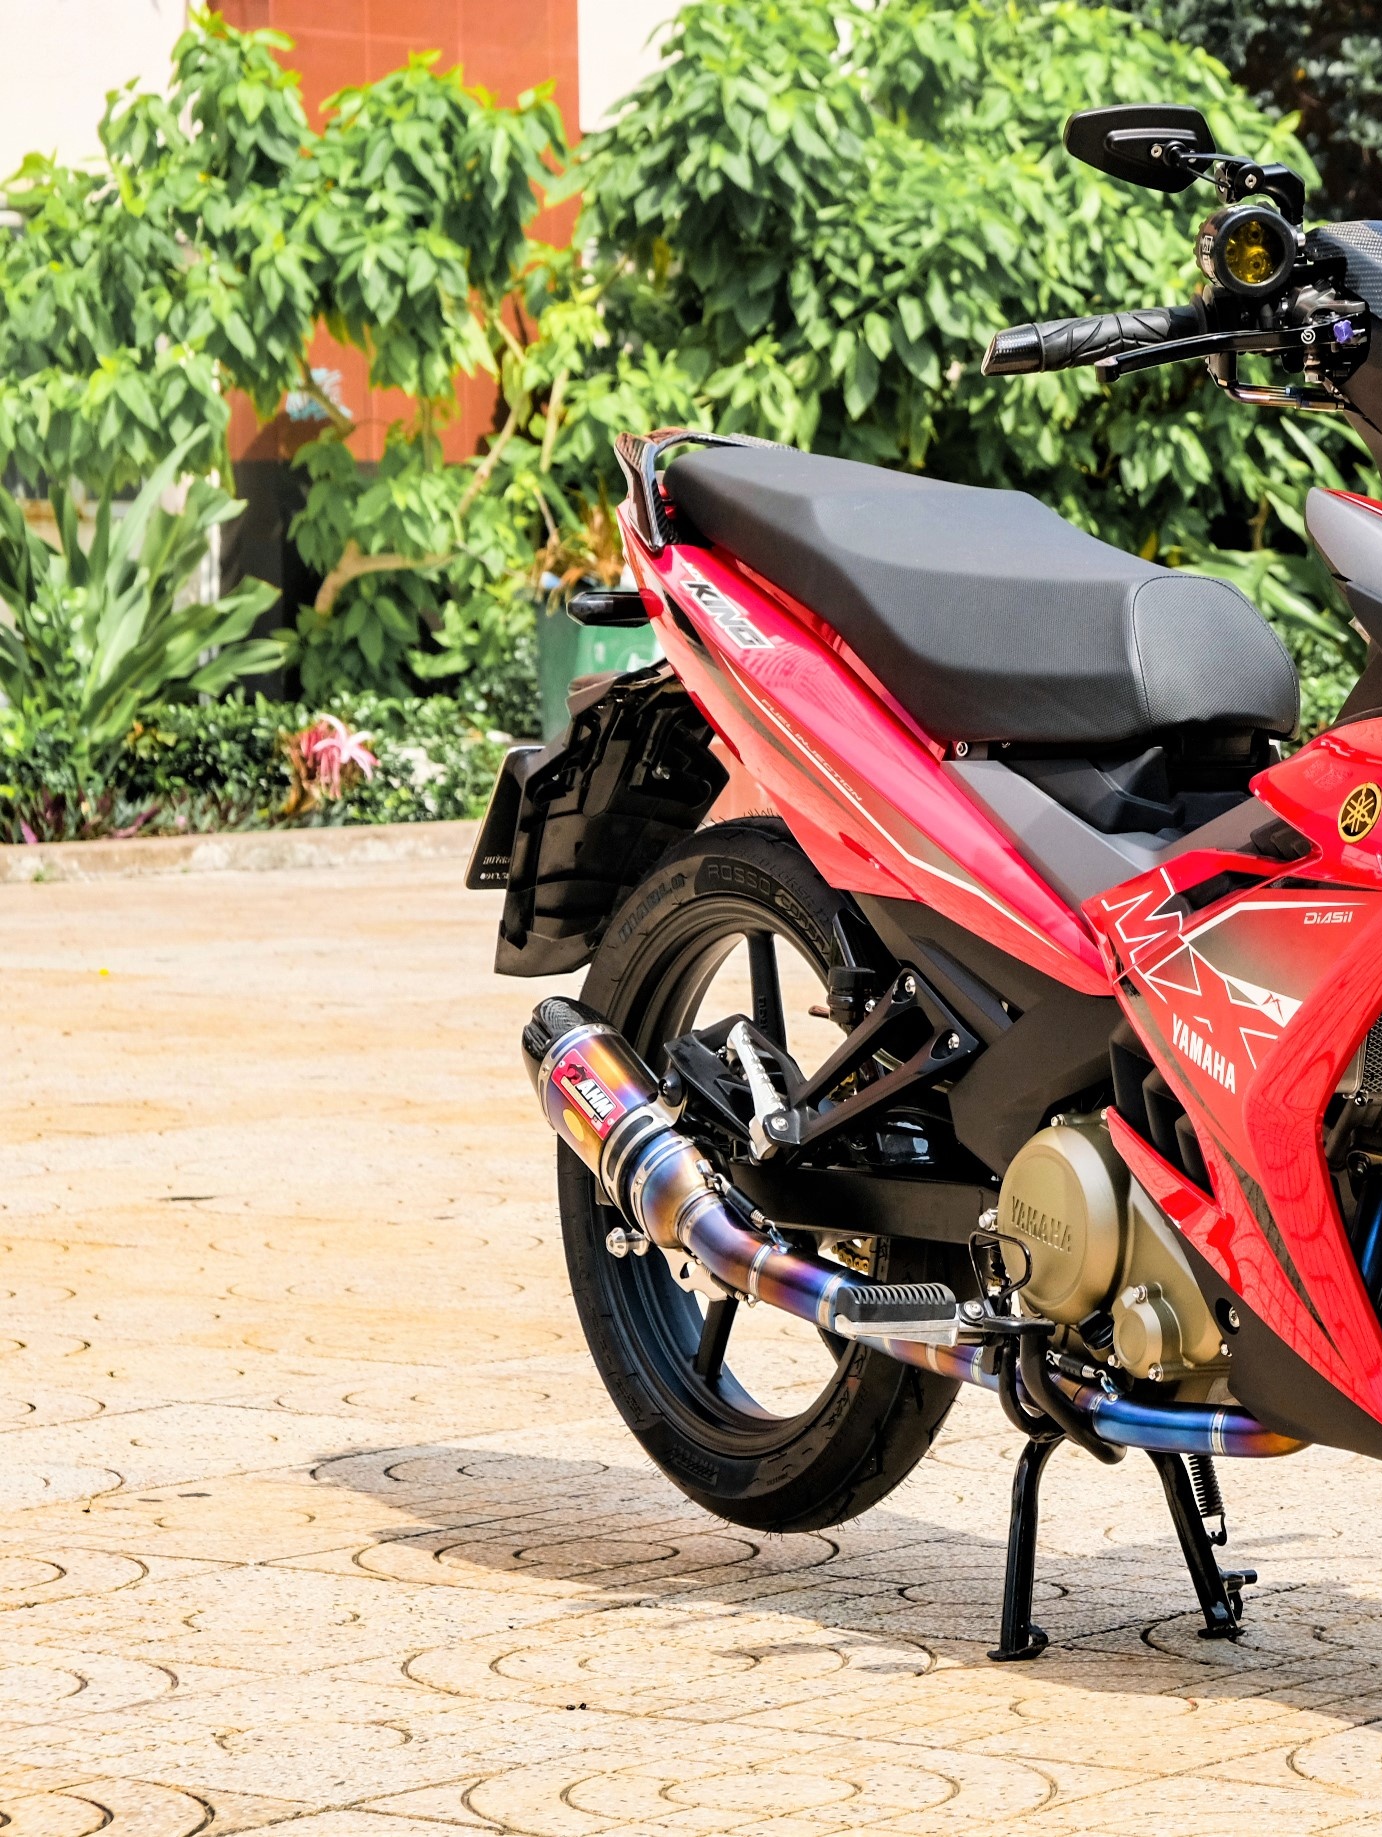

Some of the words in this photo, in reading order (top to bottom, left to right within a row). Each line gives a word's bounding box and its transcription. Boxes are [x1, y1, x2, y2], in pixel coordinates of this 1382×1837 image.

[680, 581, 776, 649] KING
[762, 699, 793, 732] FUEL
[795, 733, 862, 801] INJECTION
[707, 864, 771, 896] ROSSO
[1172, 1012, 1236, 1095] YAMAHA
[575, 1079, 617, 1121] AHM
[1009, 1195, 1072, 1255] YAMAHA
